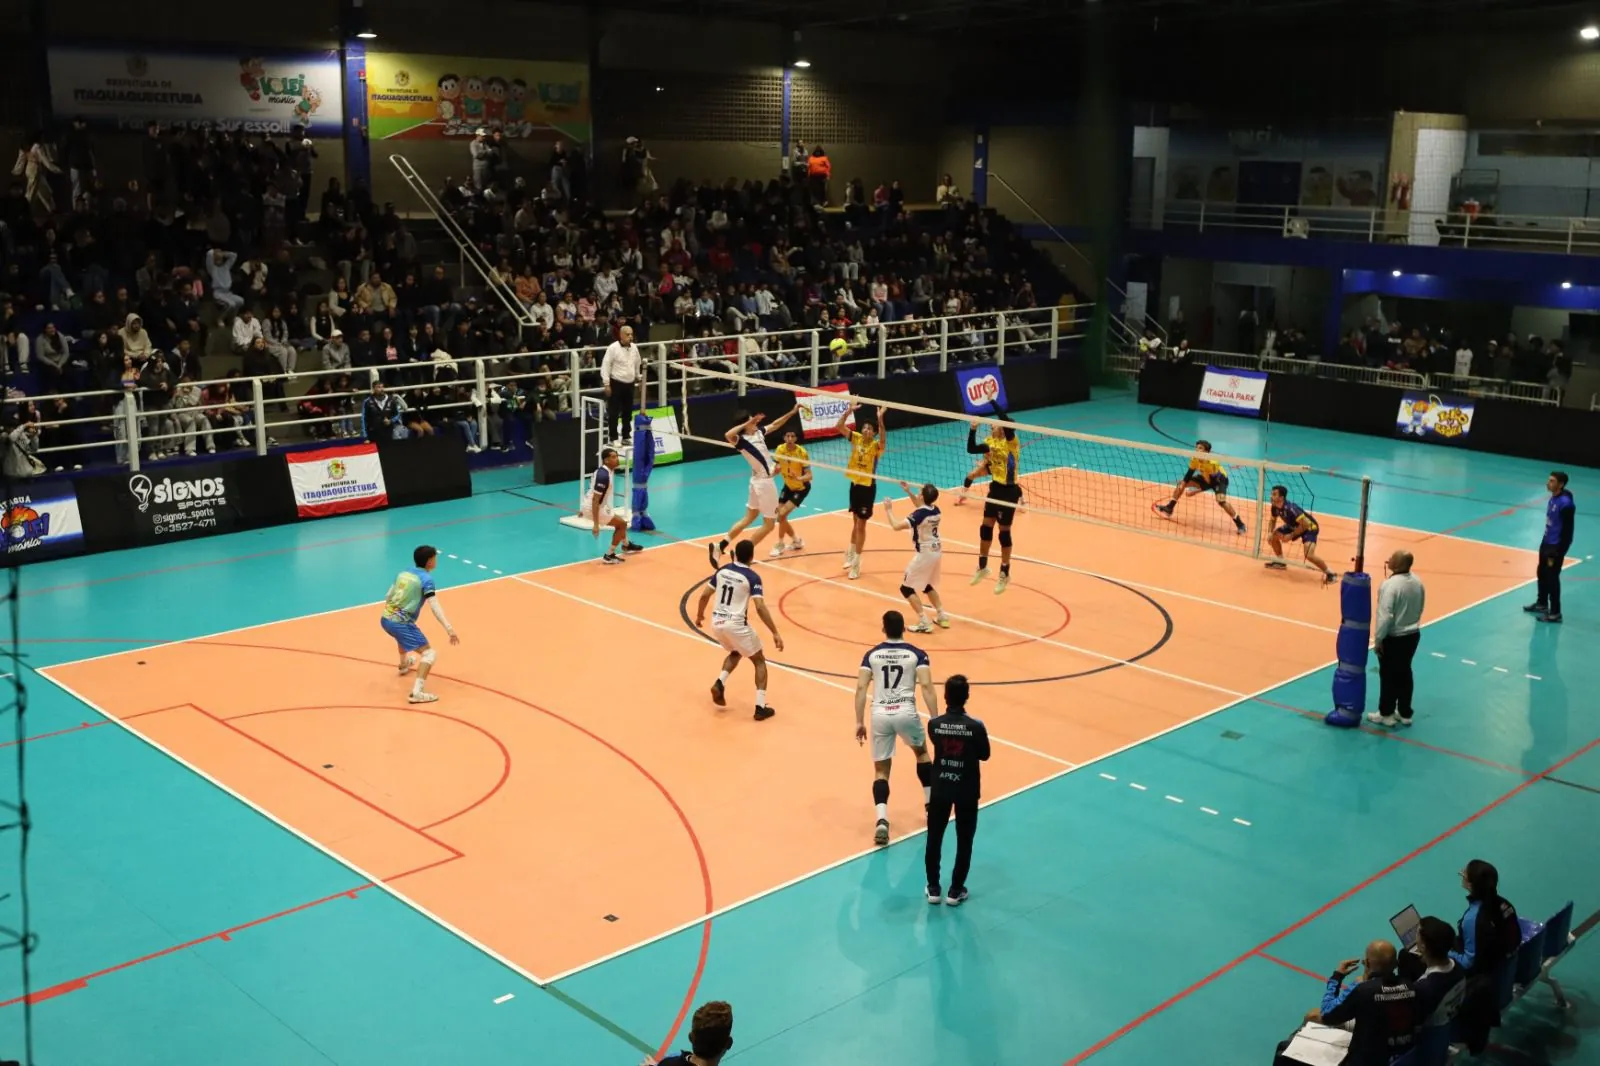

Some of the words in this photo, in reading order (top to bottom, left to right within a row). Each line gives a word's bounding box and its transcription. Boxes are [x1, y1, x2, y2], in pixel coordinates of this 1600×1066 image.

[74, 89, 203, 104] ITAQUAQUECETUBA
[1207, 388, 1234, 399] ITAQUA
[1235, 392, 1256, 401] PARK
[303, 483, 378, 499] ITAQUAQUECETUBA
[177, 498, 227, 510] SPORTS
[163, 508, 214, 524] signos_sports
[169, 518, 217, 533] 3527-4711
[721, 584, 734, 606] 11
[881, 665, 904, 690] 17
[939, 771, 961, 782] APEX
